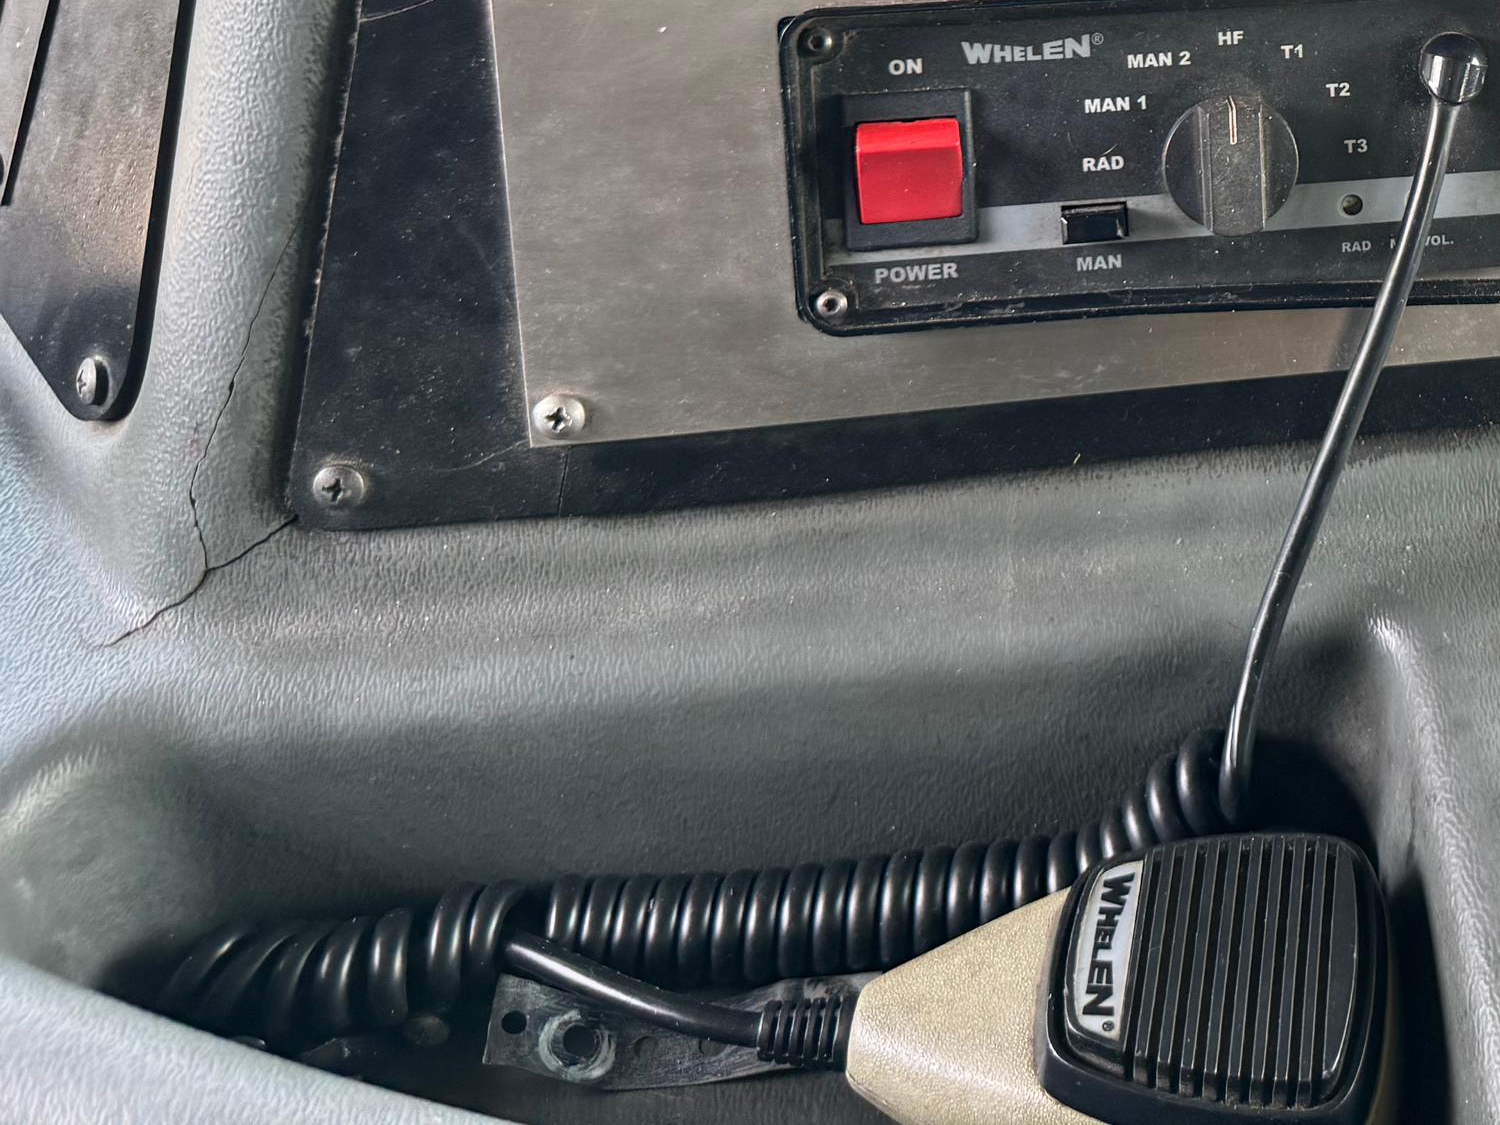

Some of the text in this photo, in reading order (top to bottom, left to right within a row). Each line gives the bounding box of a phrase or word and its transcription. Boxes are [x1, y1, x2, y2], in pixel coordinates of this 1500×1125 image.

[1217, 30, 1244, 46] HF
[1127, 50, 1192, 69] MAN 2
[1280, 43, 1304, 59] T1
[888, 58, 923, 76] ON
[1325, 82, 1351, 97] T2
[1084, 94, 1147, 114] MAN 1
[1343, 138, 1368, 154] T3
[1082, 155, 1125, 172] RAD
[1341, 240, 1372, 253] RAD
[1076, 254, 1122, 272] MAN
[874, 262, 959, 284] POWER
